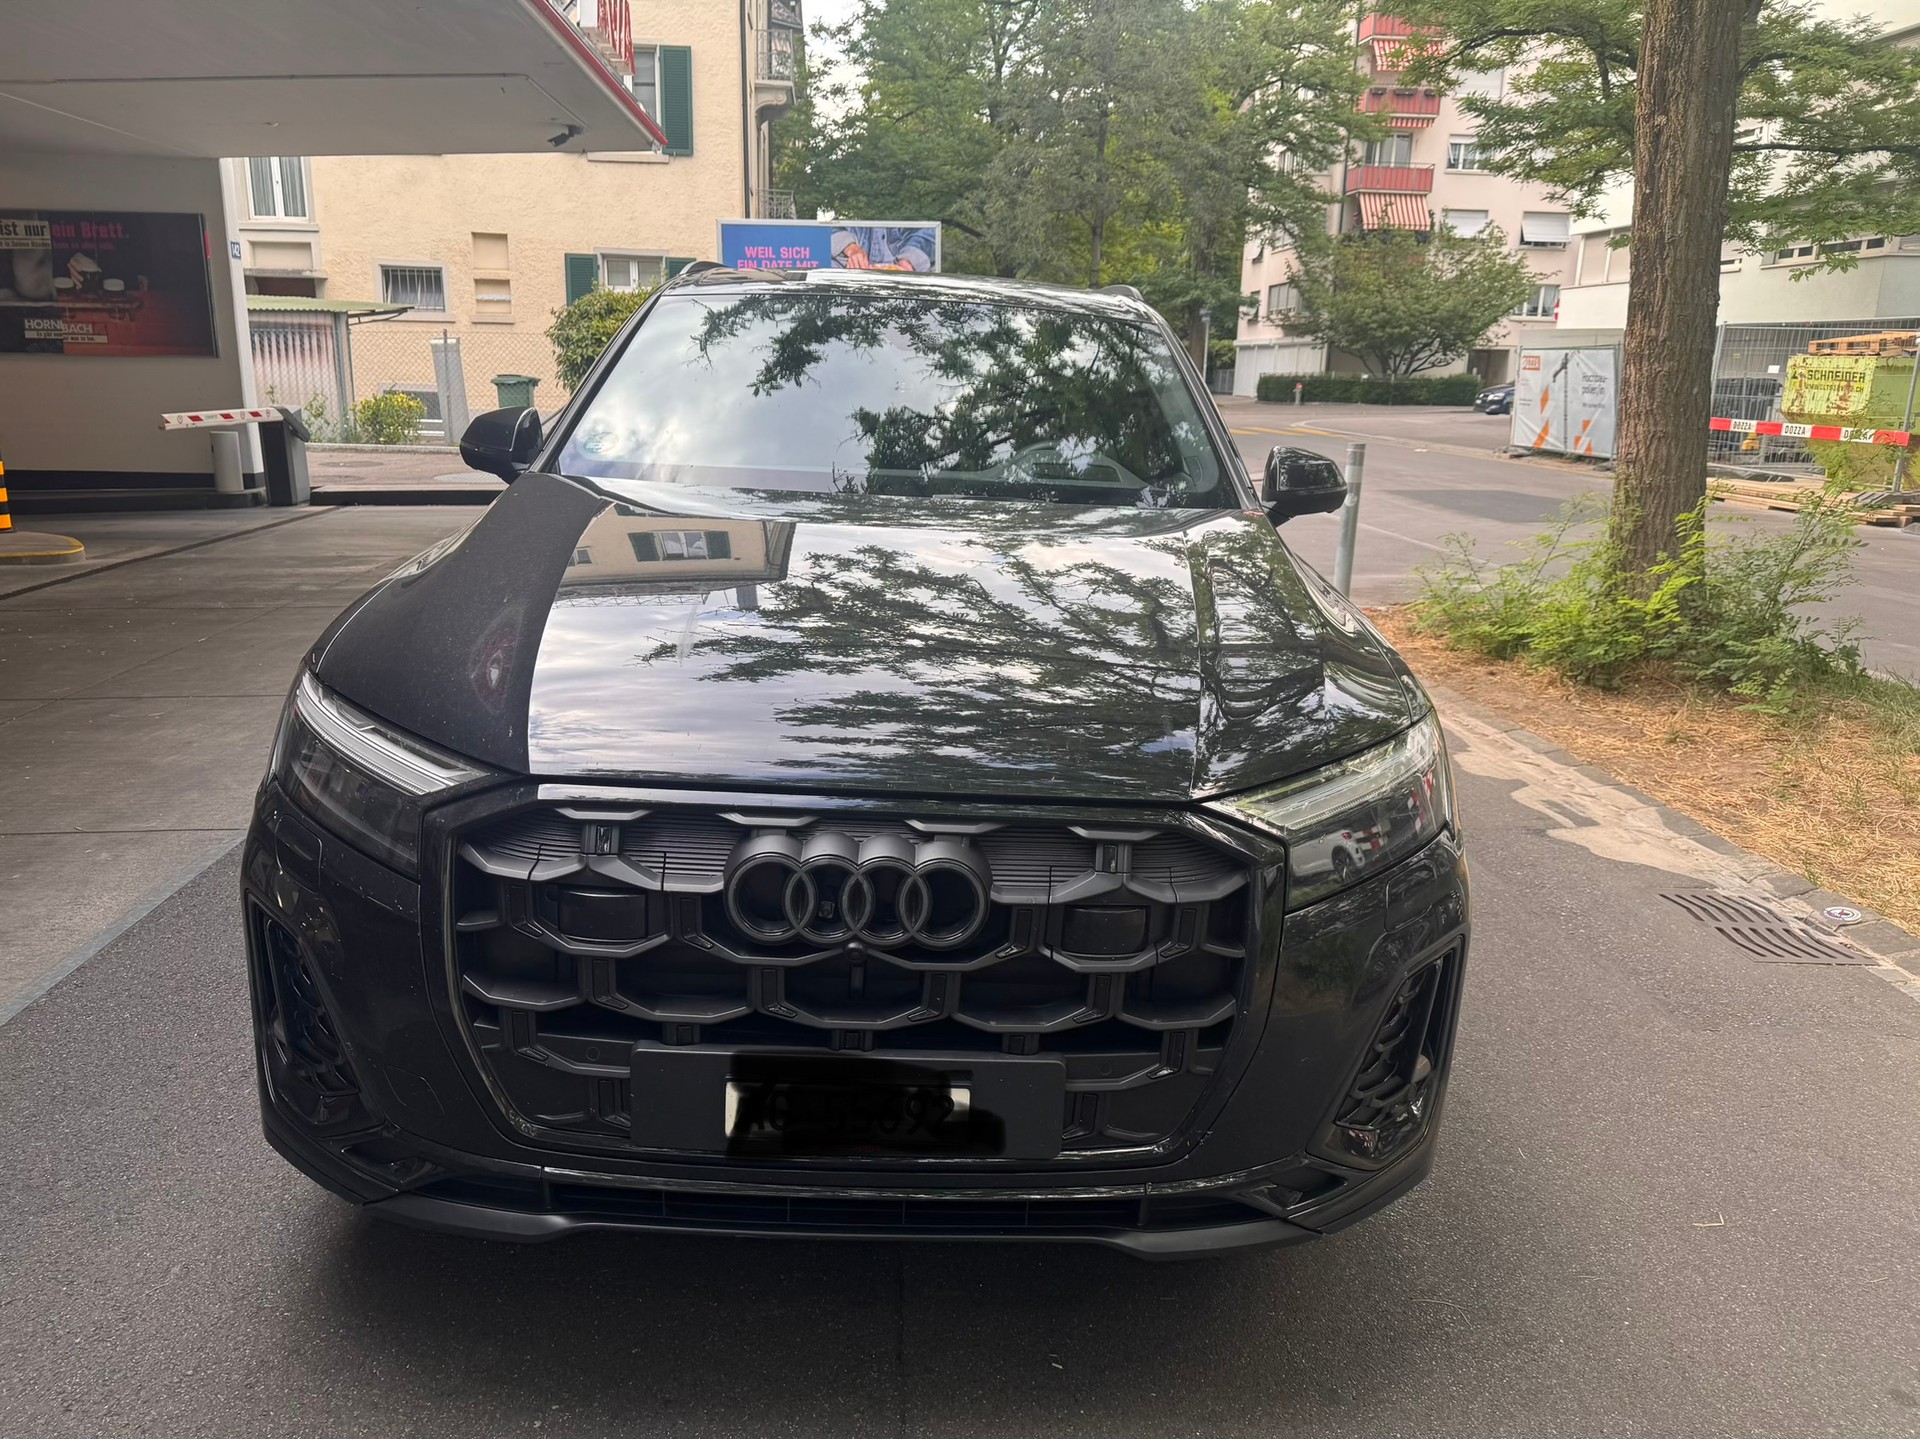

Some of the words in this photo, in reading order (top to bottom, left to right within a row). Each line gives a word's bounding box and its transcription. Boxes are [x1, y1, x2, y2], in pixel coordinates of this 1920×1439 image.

[24, 224, 46, 237] nur
[52, 222, 76, 238] ein
[231, 243, 241, 257] 142
[745, 246, 776, 258] WEIL
[780, 247, 810, 259] SICH
[737, 260, 758, 269] EIN
[762, 260, 793, 269] DATE
[24, 319, 94, 334] HORNBACH
[1807, 369, 1866, 383] SCHNEIDER
[1733, 420, 1752, 430] DOZZA
[1784, 424, 1806, 435] DOZZA
